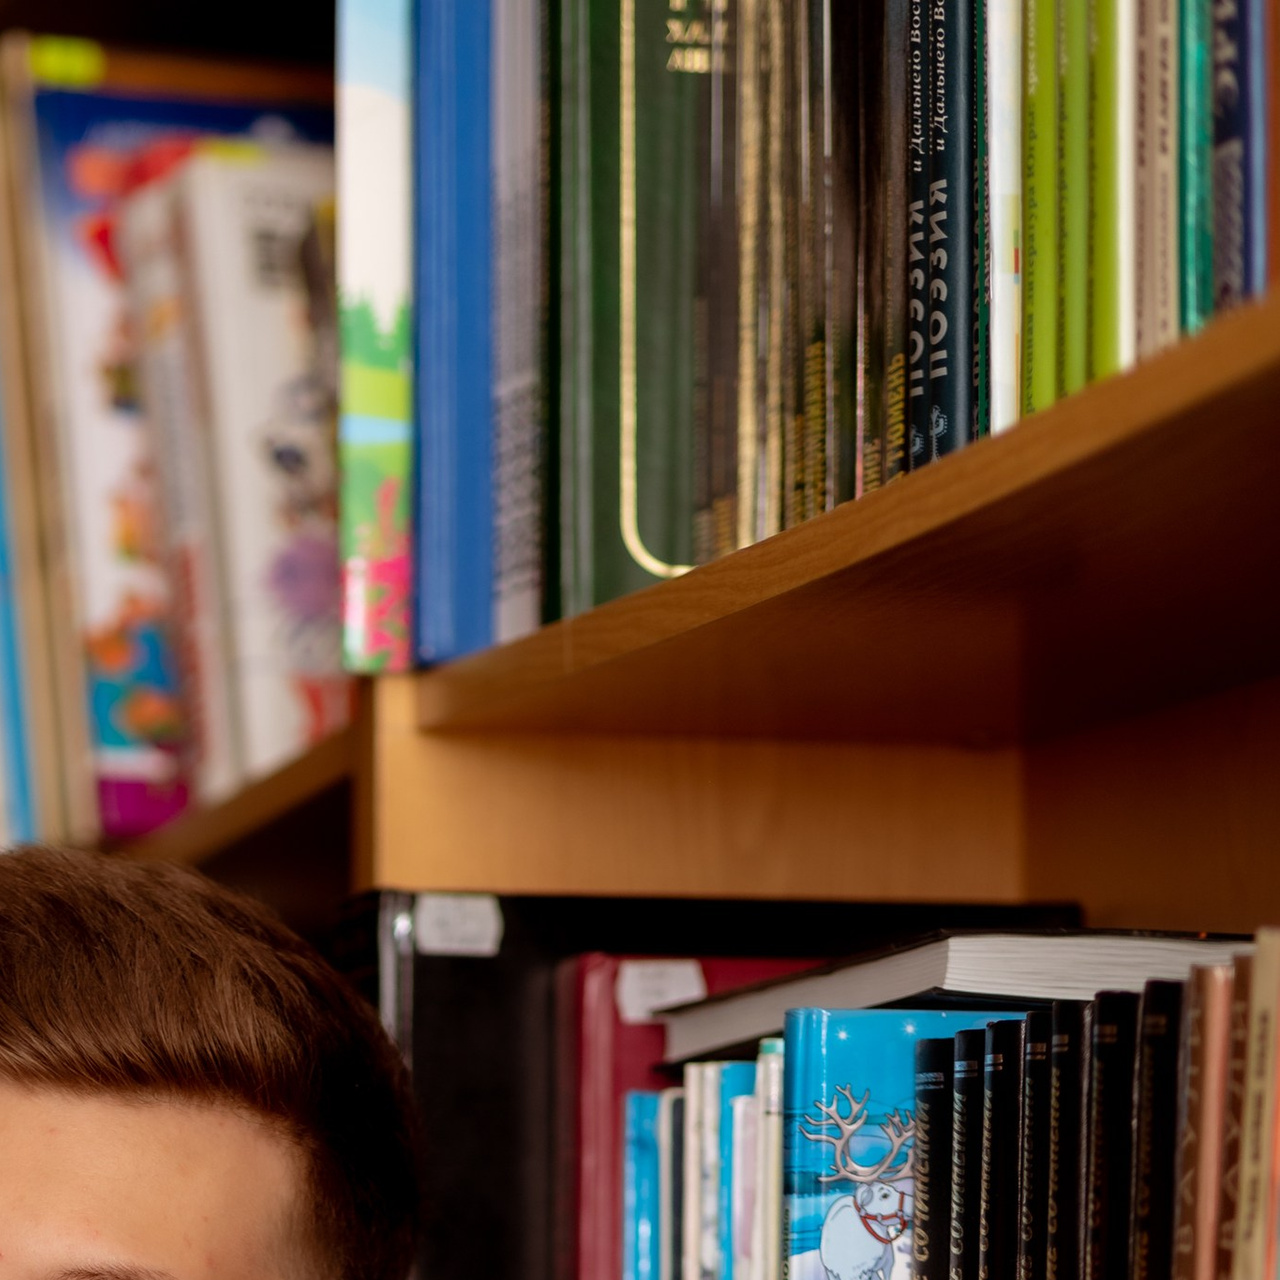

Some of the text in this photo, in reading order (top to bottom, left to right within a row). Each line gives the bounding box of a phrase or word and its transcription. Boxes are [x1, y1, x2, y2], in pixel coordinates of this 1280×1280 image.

[909, 50, 925, 155] Дальнего
[932, 27, 949, 133] Дальнего
[908, 199, 924, 397] ПОЭЗИЯ
[929, 178, 948, 380] ПОЭЗИЯ
[886, 352, 906, 468] ТЮМЕНЬ
